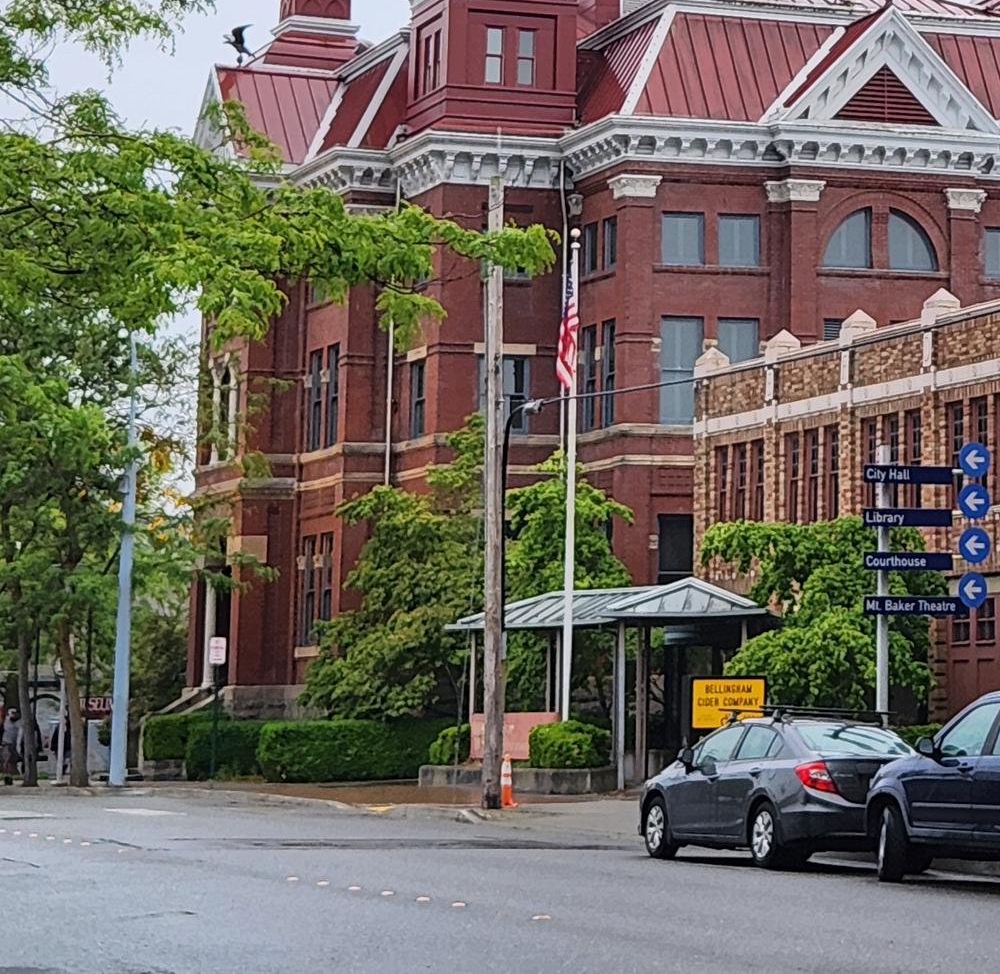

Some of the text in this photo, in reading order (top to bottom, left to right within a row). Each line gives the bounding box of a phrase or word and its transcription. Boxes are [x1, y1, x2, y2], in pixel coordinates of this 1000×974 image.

[866, 468, 910, 482] City Hall
[865, 511, 905, 526] Library
[866, 555, 927, 567] Courthouse
[884, 599, 916, 611] Baker
[918, 599, 957, 612] Theatre
[705, 684, 752, 694] BELLINGHAM
[697, 697, 759, 707] CIDER COMPANY
